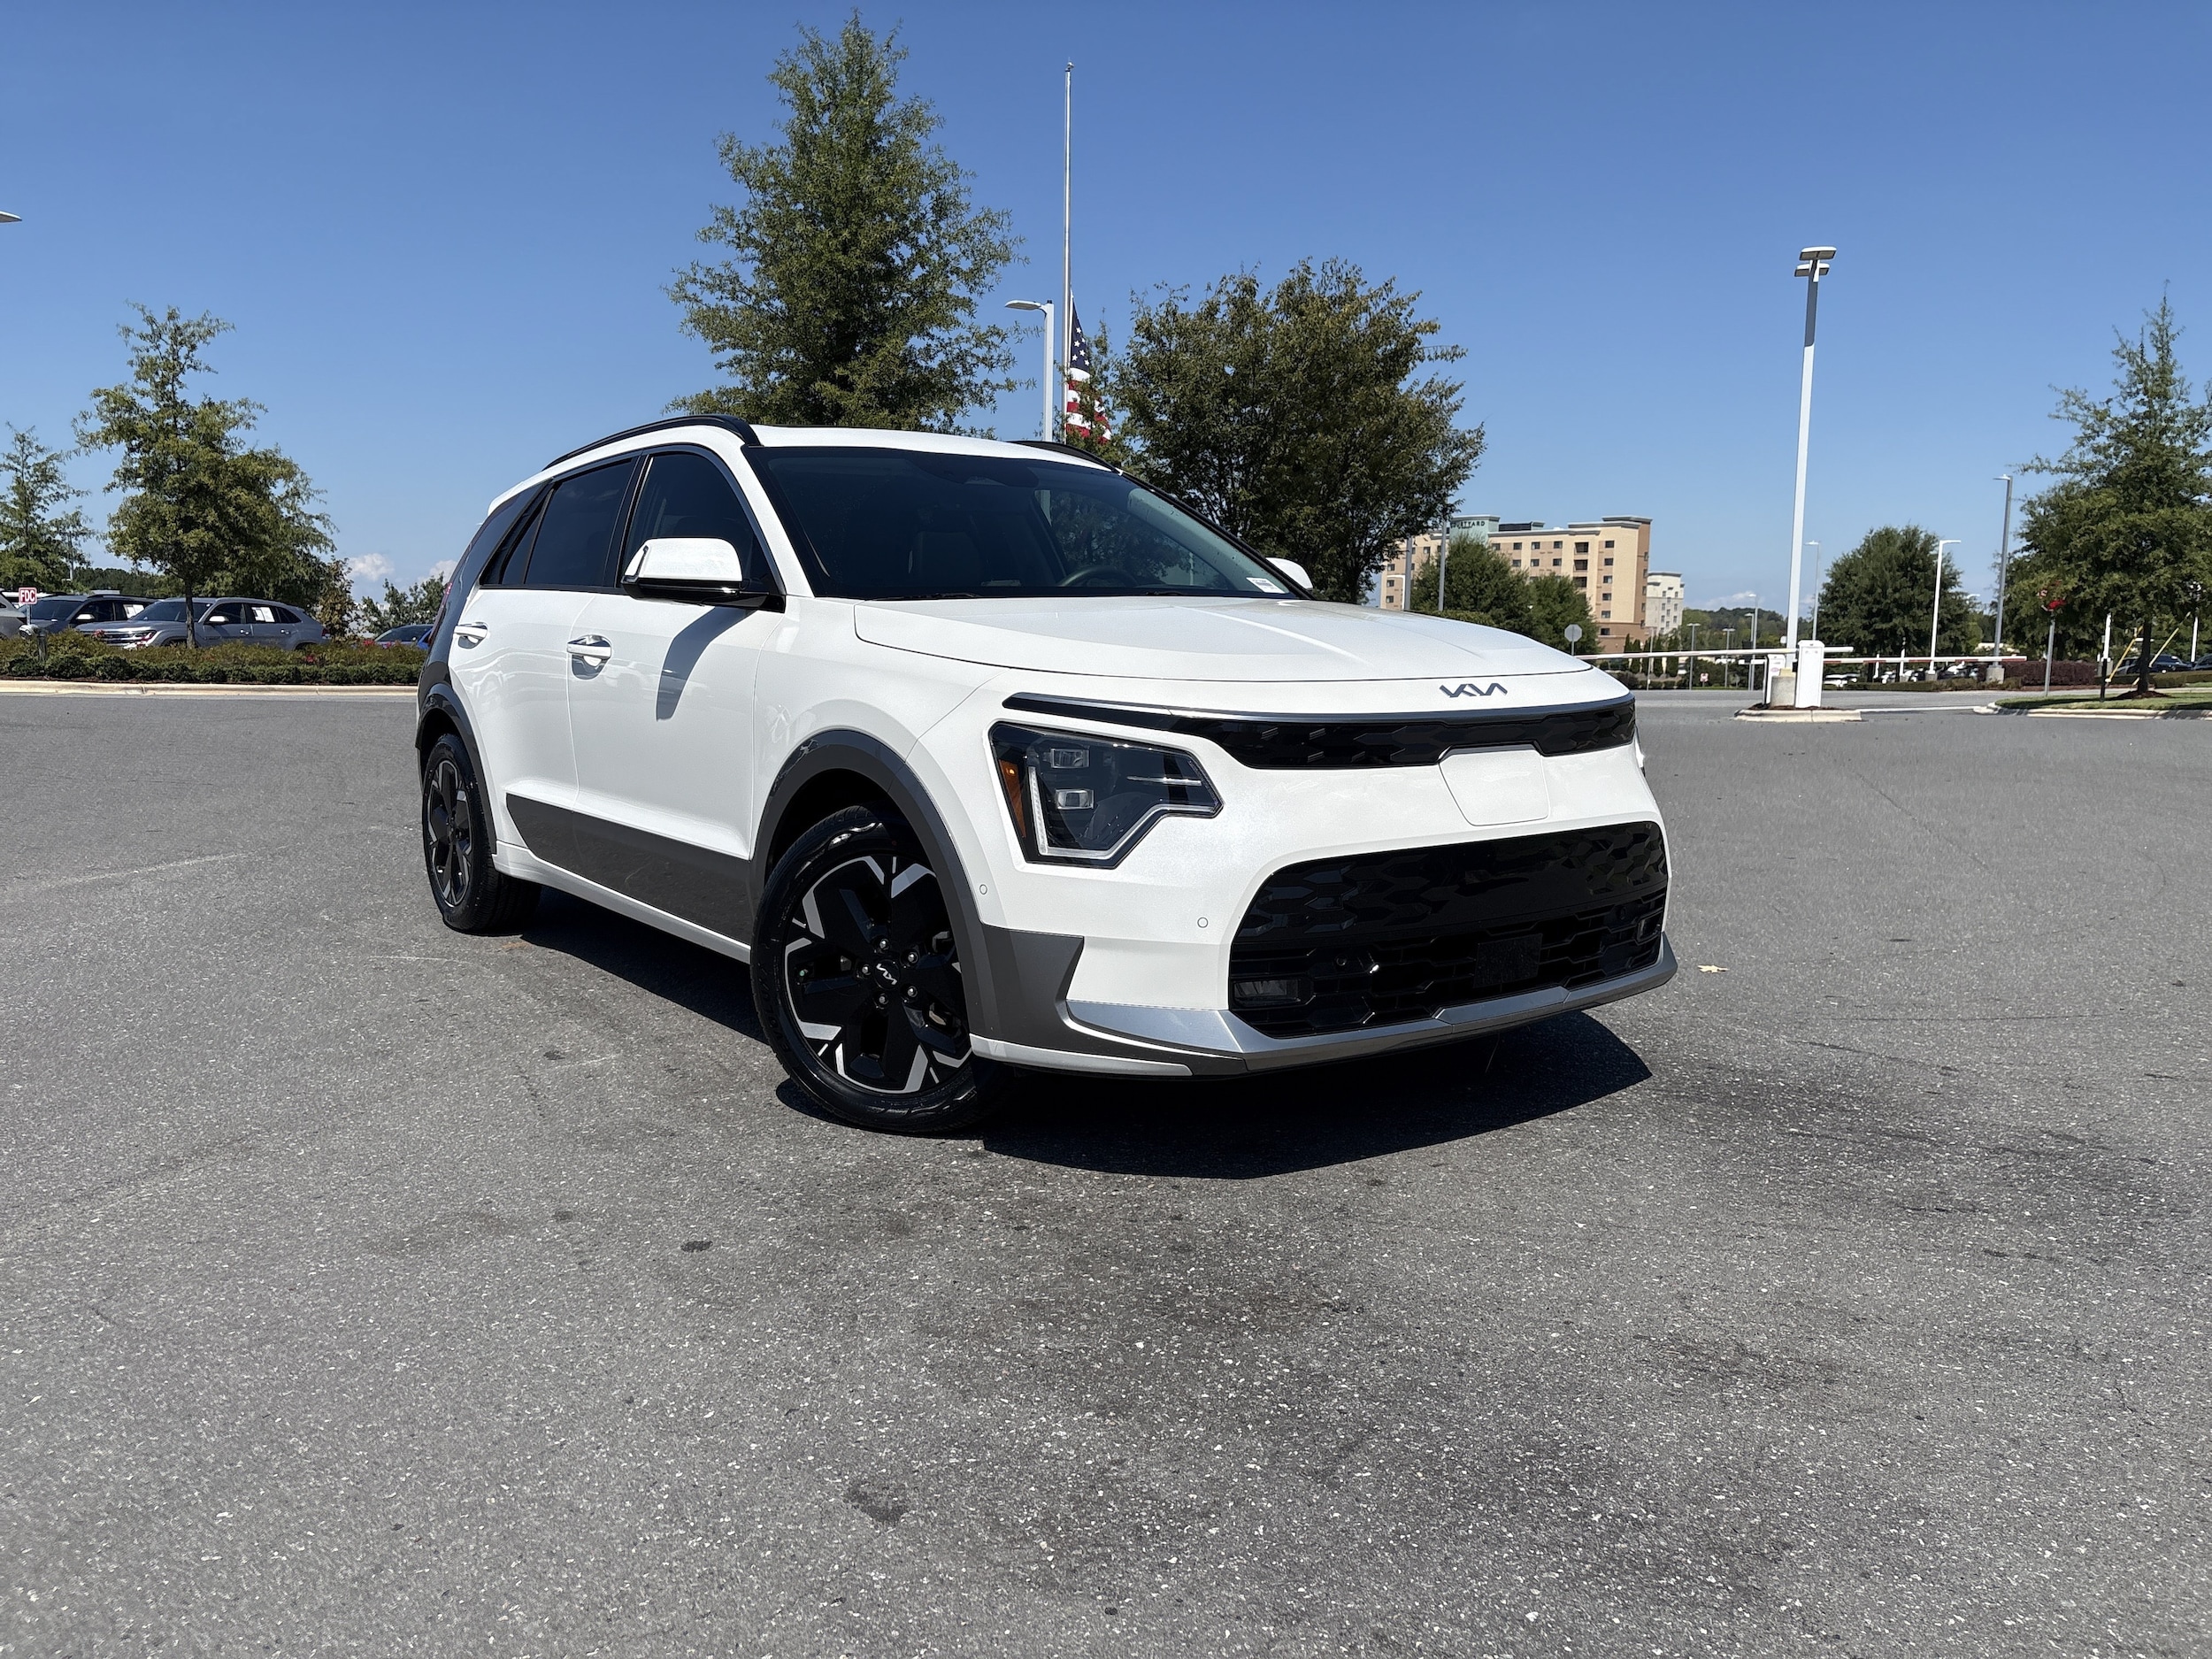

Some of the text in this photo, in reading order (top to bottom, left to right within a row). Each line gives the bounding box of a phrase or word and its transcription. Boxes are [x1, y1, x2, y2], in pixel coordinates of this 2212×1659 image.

[20, 589, 35, 603] FDC
[1439, 682, 1508, 698] KIA
[876, 963, 898, 986] KIA
